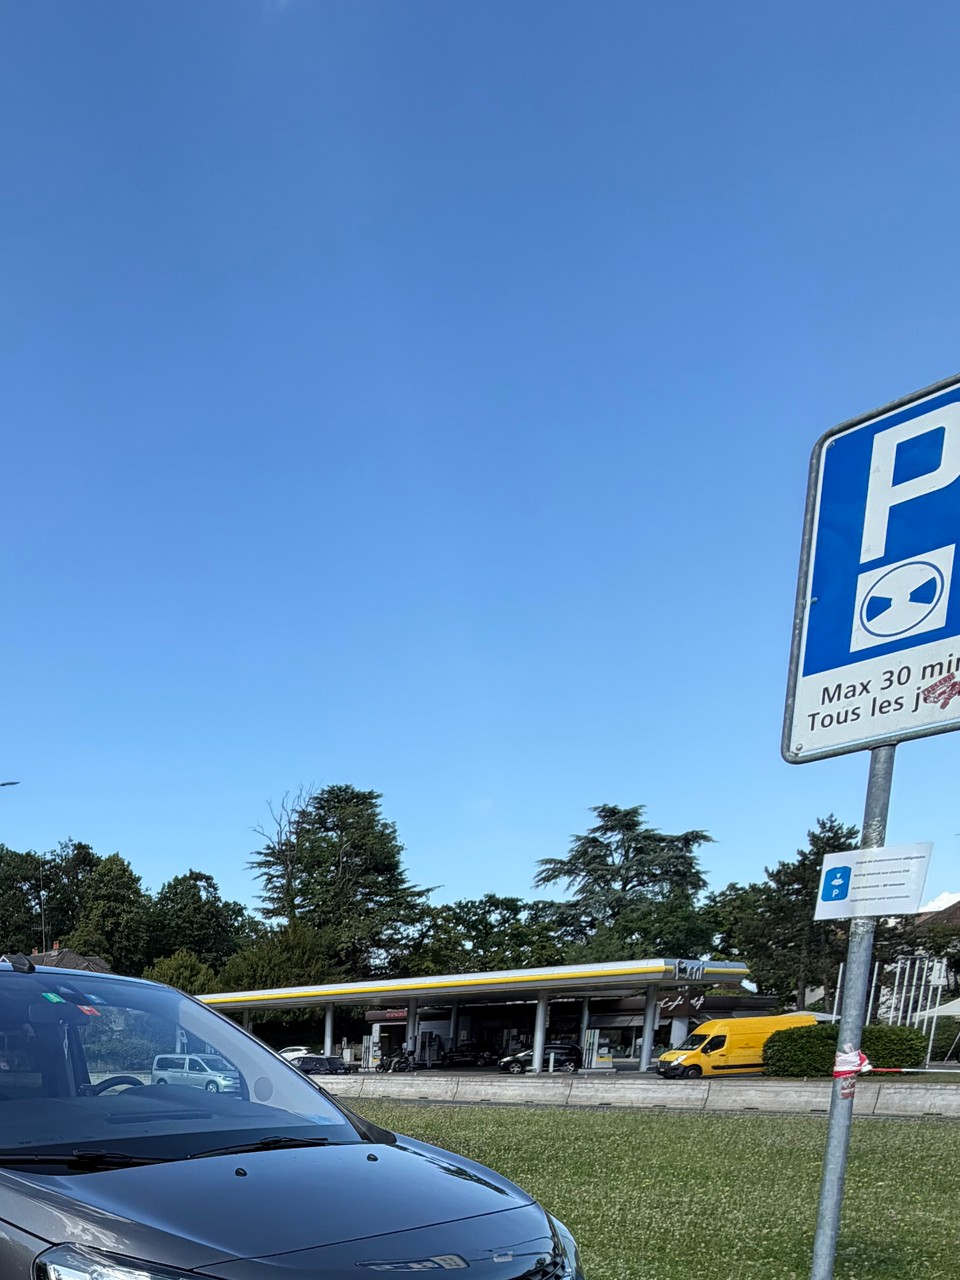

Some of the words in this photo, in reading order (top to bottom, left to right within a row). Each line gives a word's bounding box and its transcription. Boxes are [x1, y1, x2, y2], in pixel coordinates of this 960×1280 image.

[859, 401, 960, 564] P
[821, 680, 872, 705] Max
[880, 666, 911, 690] 30
[807, 706, 861, 731] Tous
[871, 696, 904, 717] les
